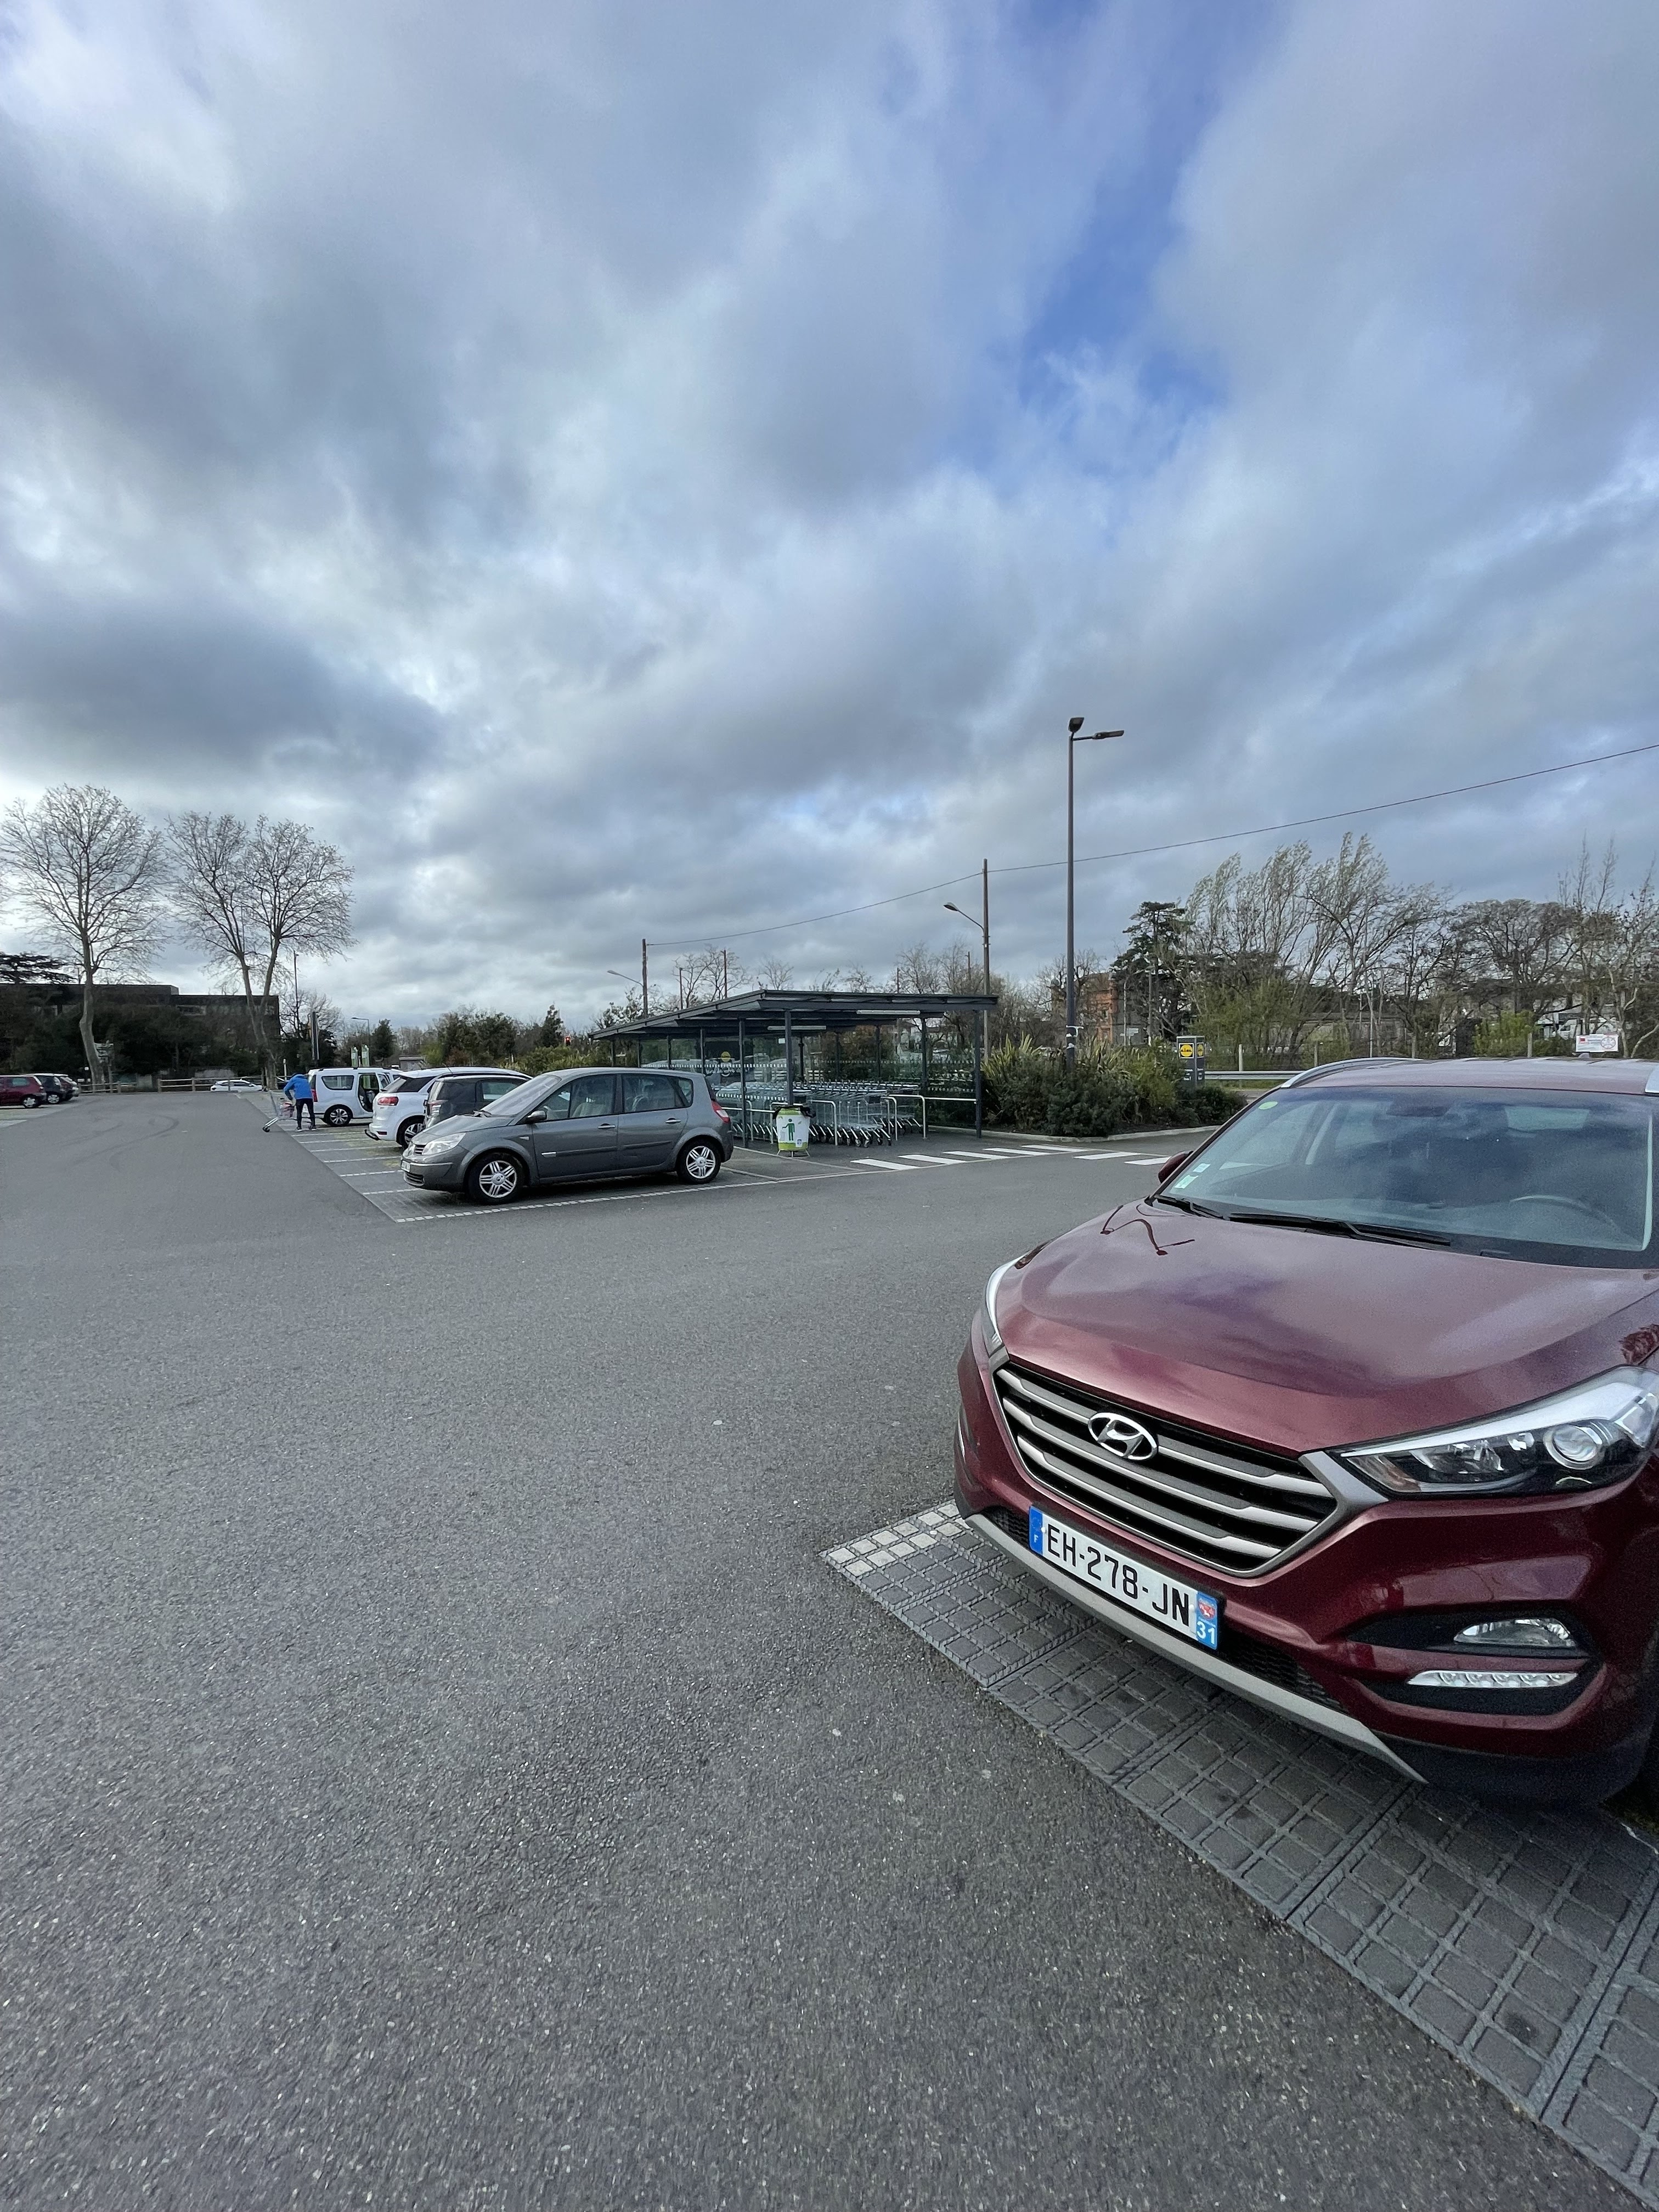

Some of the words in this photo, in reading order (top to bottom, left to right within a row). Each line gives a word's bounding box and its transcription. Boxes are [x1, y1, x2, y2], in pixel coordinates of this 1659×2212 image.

[1034, 1534, 1039, 1543] F
[1047, 1523, 1190, 1627] EH-278-JN
[1197, 1621, 1215, 1645] 31
